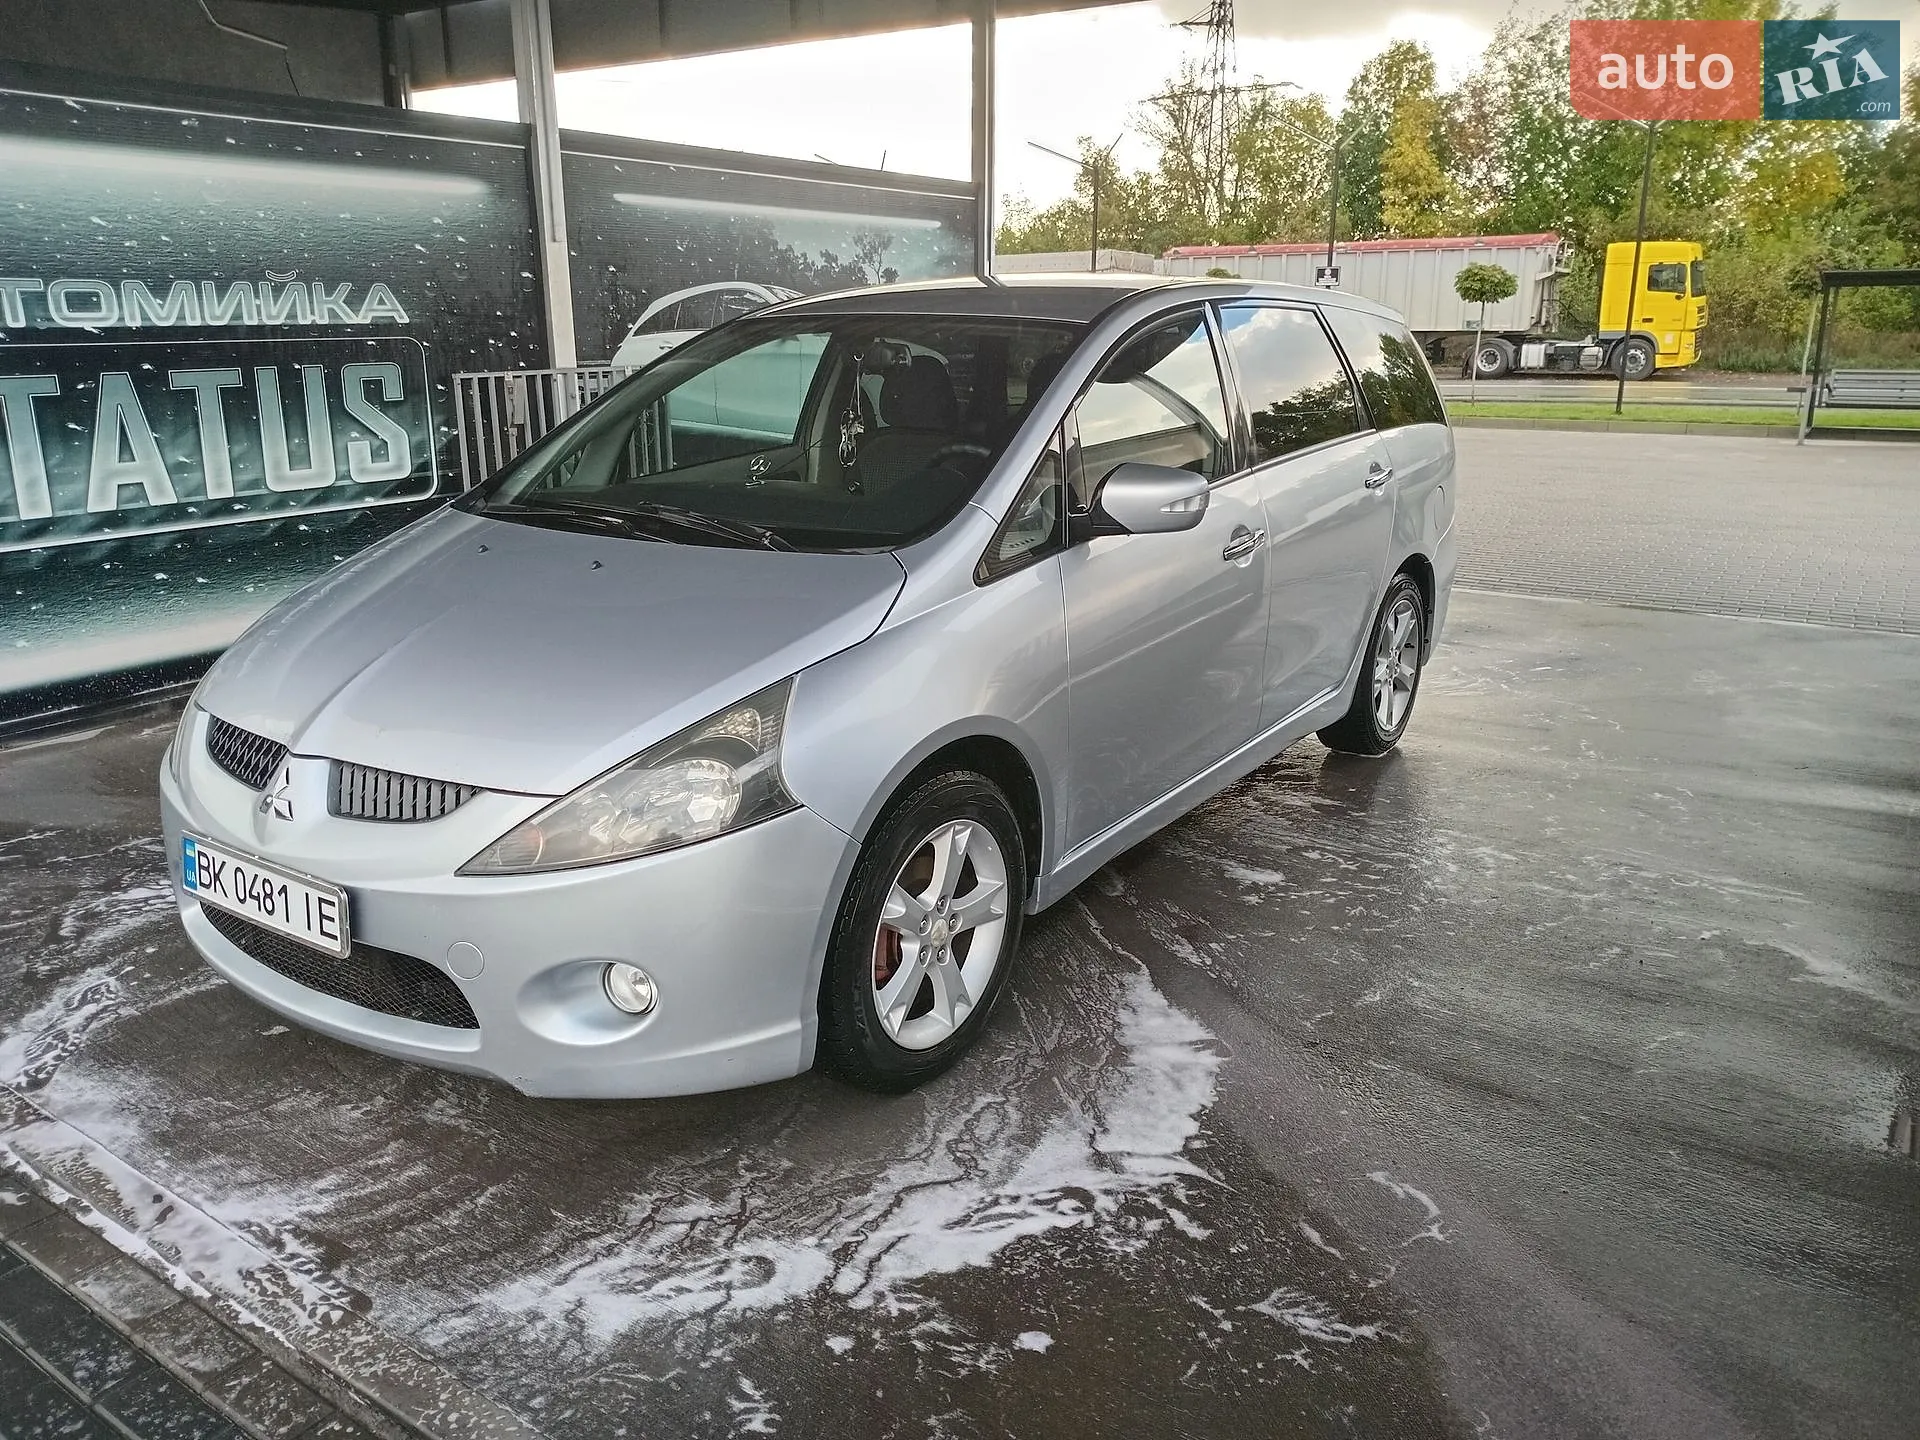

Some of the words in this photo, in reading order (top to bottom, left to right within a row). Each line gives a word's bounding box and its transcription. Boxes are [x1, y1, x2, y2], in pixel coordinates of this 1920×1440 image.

[186, 869, 196, 883] UA
[197, 850, 228, 898] BK
[234, 867, 290, 923] 0481
[305, 892, 338, 941] IE
